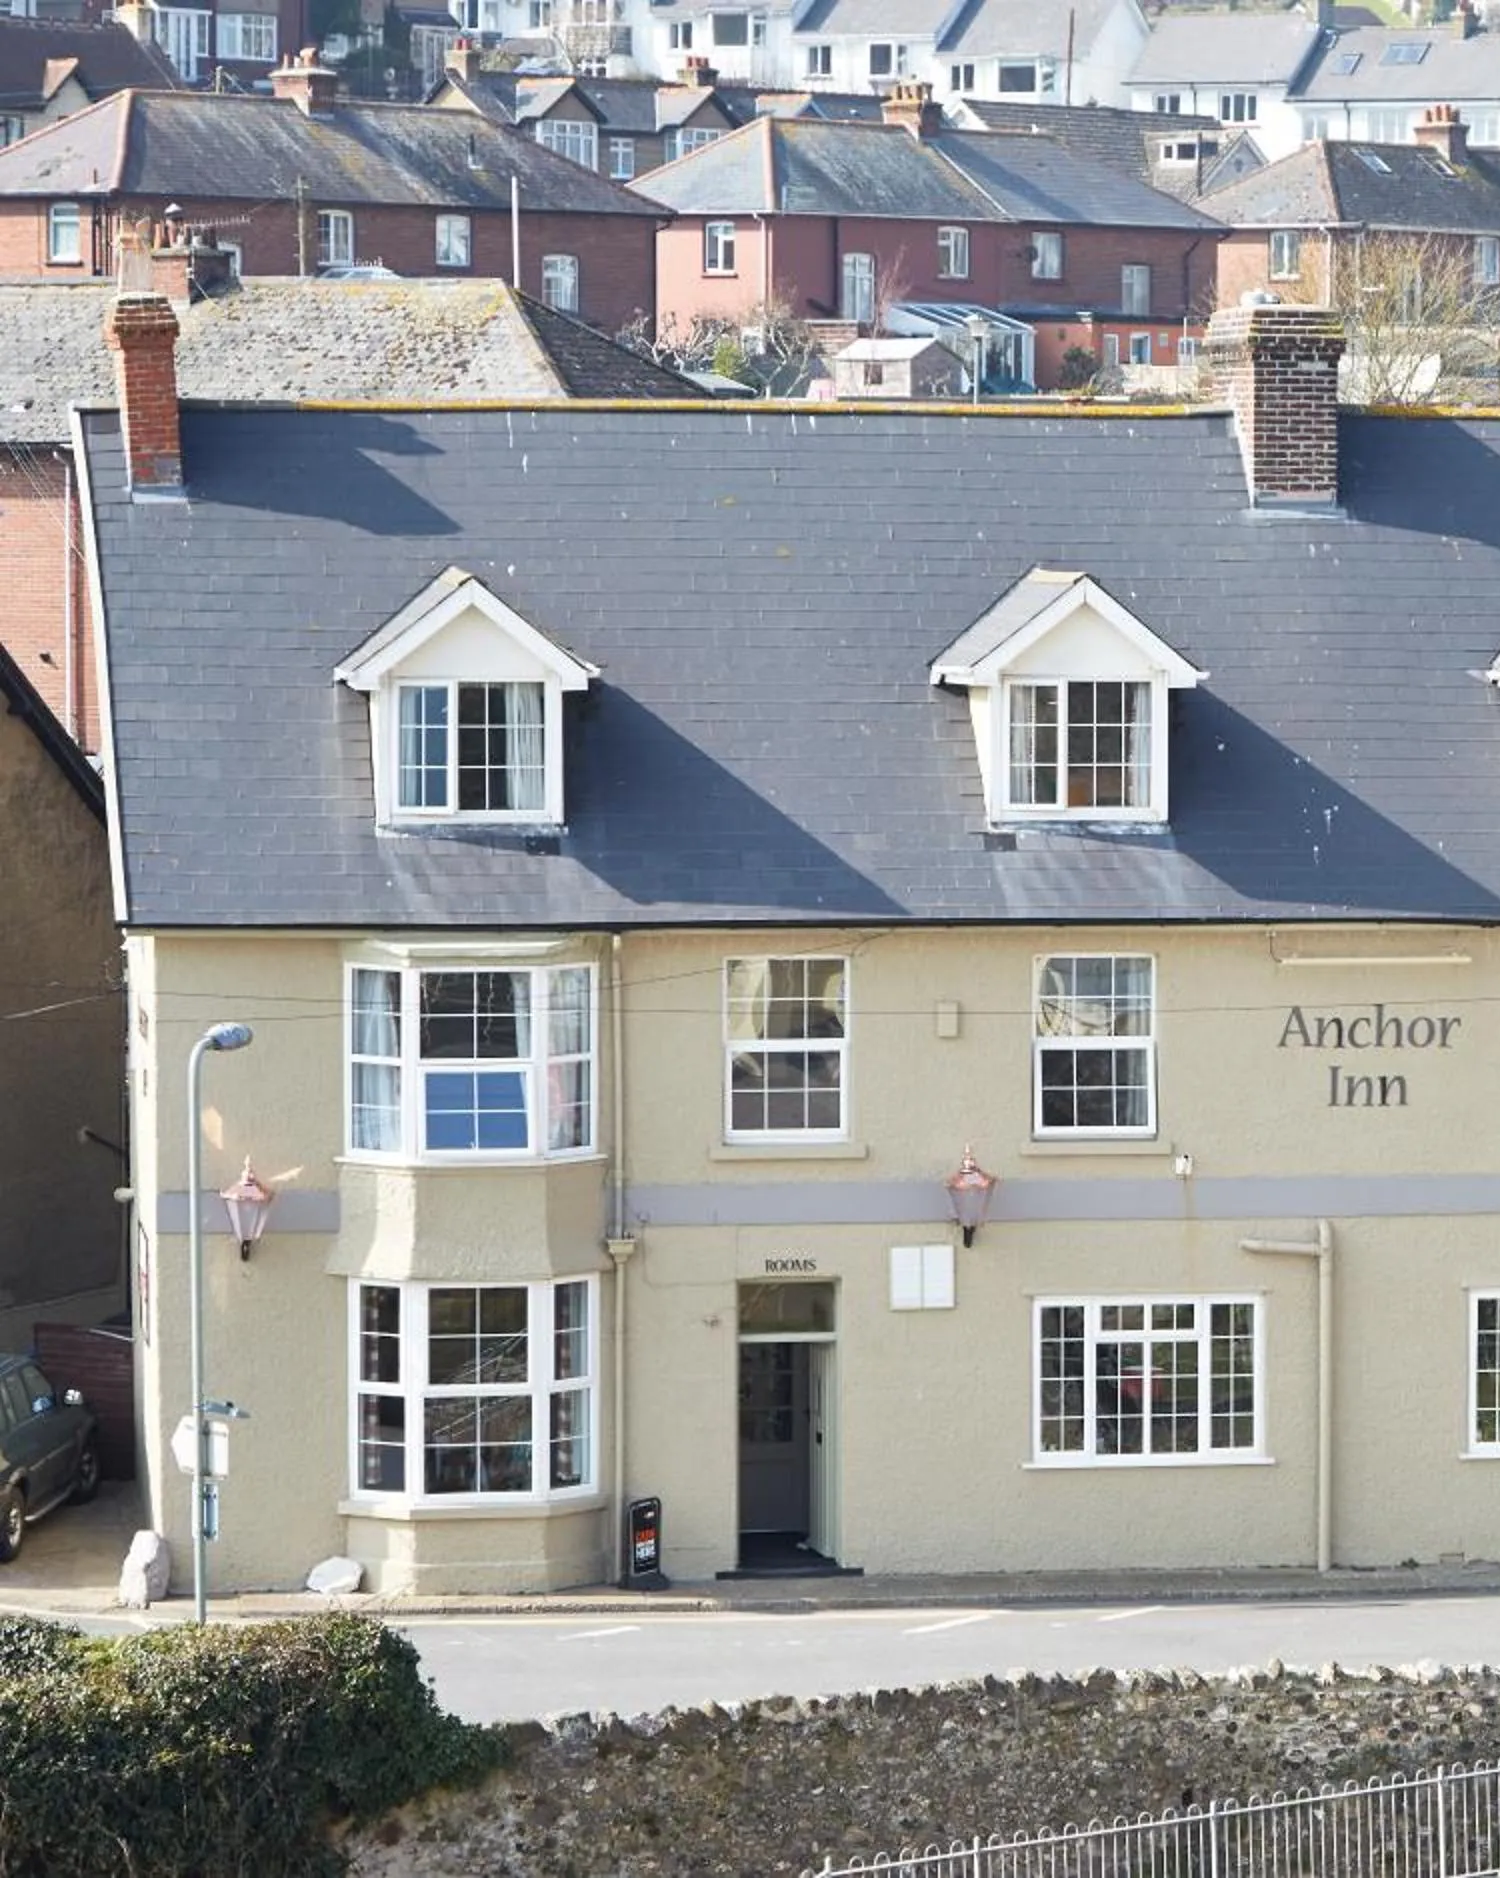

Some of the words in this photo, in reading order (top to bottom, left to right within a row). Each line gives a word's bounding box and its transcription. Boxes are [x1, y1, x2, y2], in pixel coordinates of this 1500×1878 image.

[1276, 1003, 1462, 1049] Anchor
[1327, 1065, 1408, 1107] Inn
[765, 1258, 817, 1272] ROOMS
